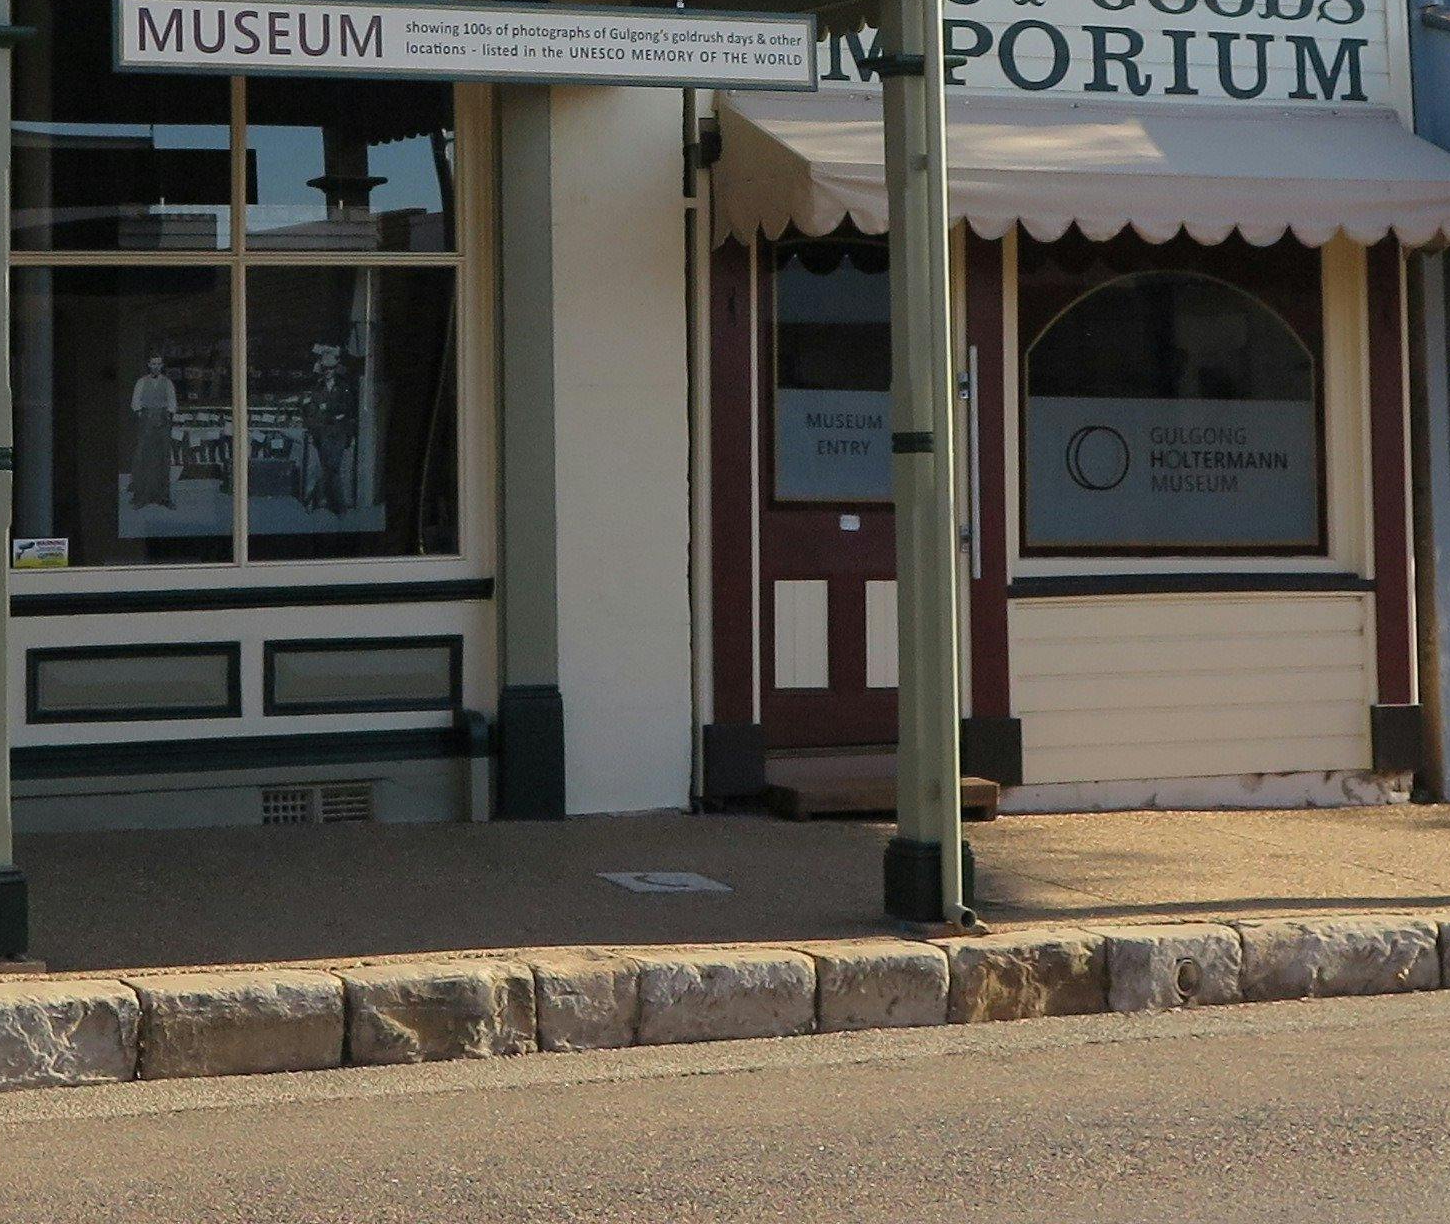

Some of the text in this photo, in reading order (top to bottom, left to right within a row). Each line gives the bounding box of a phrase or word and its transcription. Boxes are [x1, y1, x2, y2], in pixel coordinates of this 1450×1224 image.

[138, 7, 384, 59] MUSEUM
[405, 21, 802, 46] showing 100s of photographs of Gulgong's goldrush days & other
[406, 41, 466, 55] locations
[482, 43, 518, 57] listed
[524, 45, 536, 58] in
[542, 46, 563, 58] the
[569, 46, 625, 60] UNESCO
[631, 49, 695, 62] MEMORY
[700, 51, 717, 63] OF
[723, 52, 748, 64] THE
[754, 53, 802, 66] WORLD
[806, 413, 882, 429] MUSEUM
[1150, 426, 1246, 445] GULGONG
[818, 440, 870, 455] ENTRY
[1150, 449, 1288, 469] HOLTERMANN
[1150, 475, 1238, 492] MUSEUM
